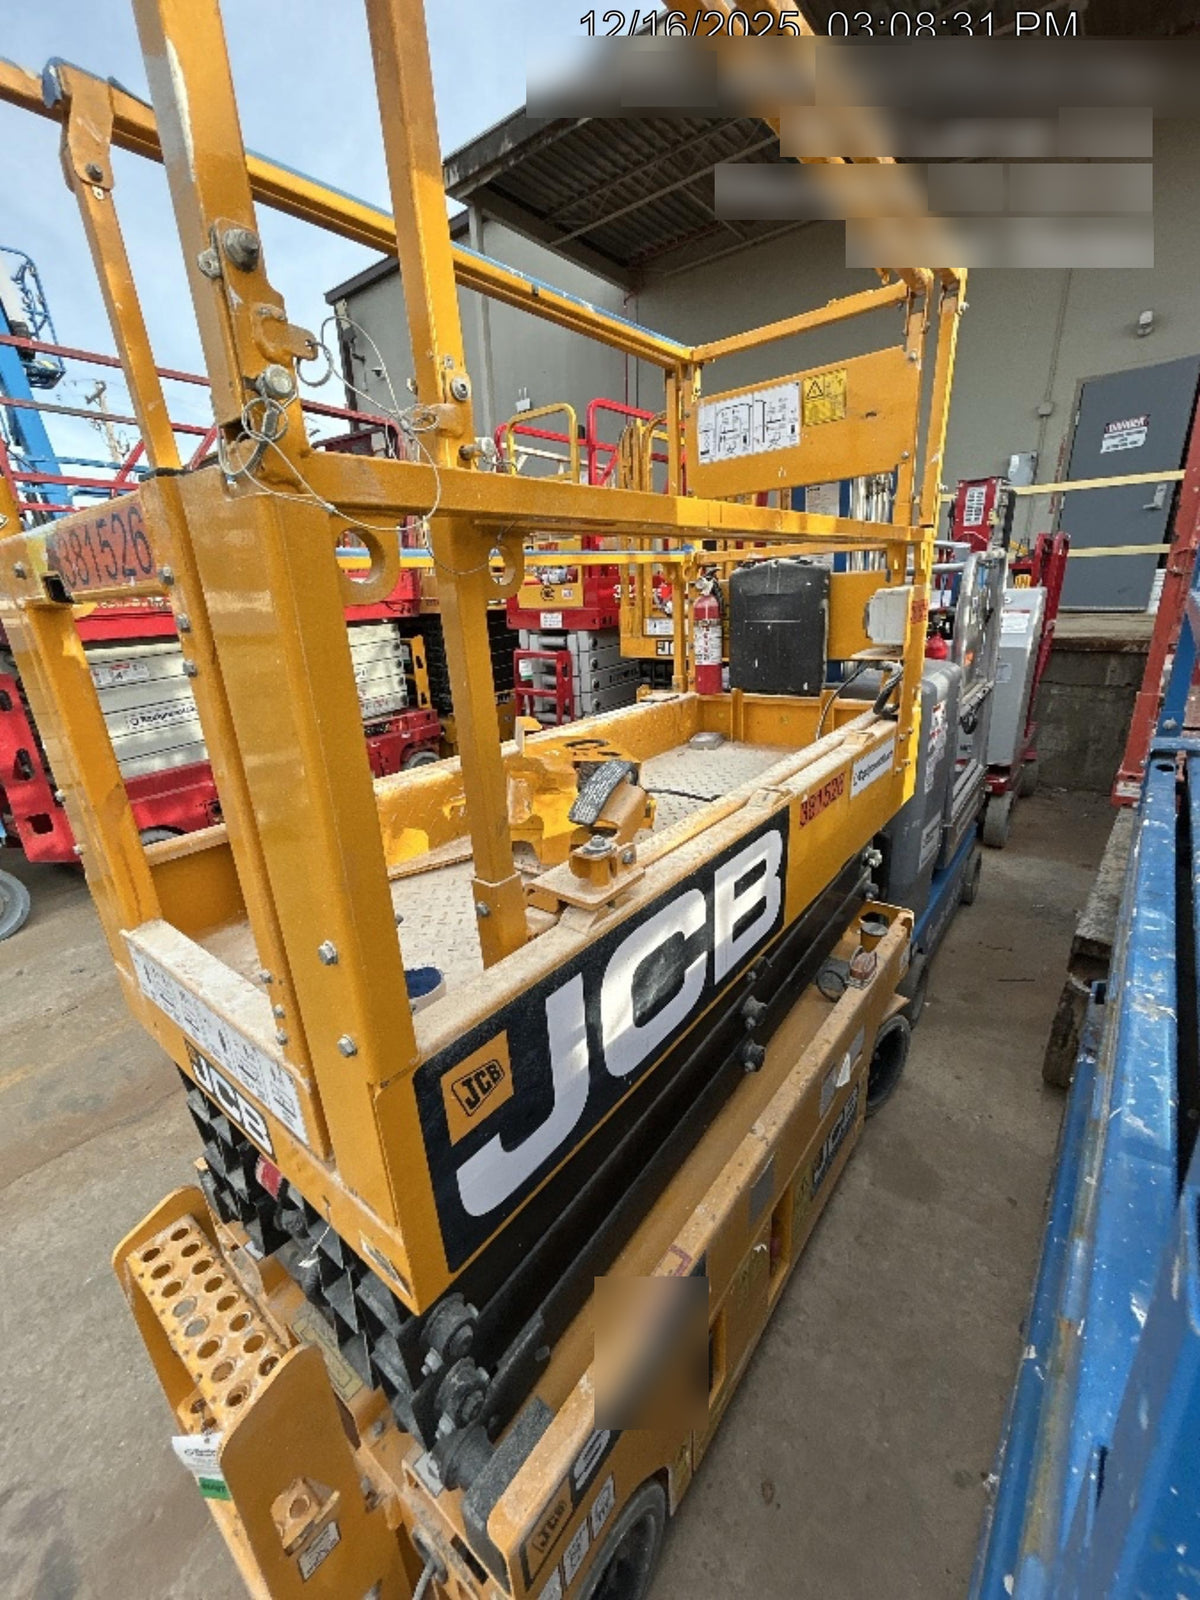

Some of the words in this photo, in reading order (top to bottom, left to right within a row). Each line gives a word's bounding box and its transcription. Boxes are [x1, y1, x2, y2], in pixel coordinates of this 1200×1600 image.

[59, 505, 153, 589] 381526
[456, 829, 783, 1217] JCB
[192, 1055, 274, 1155] JCB
[460, 1062, 501, 1111] JCB
[813, 1084, 858, 1184] JCB
